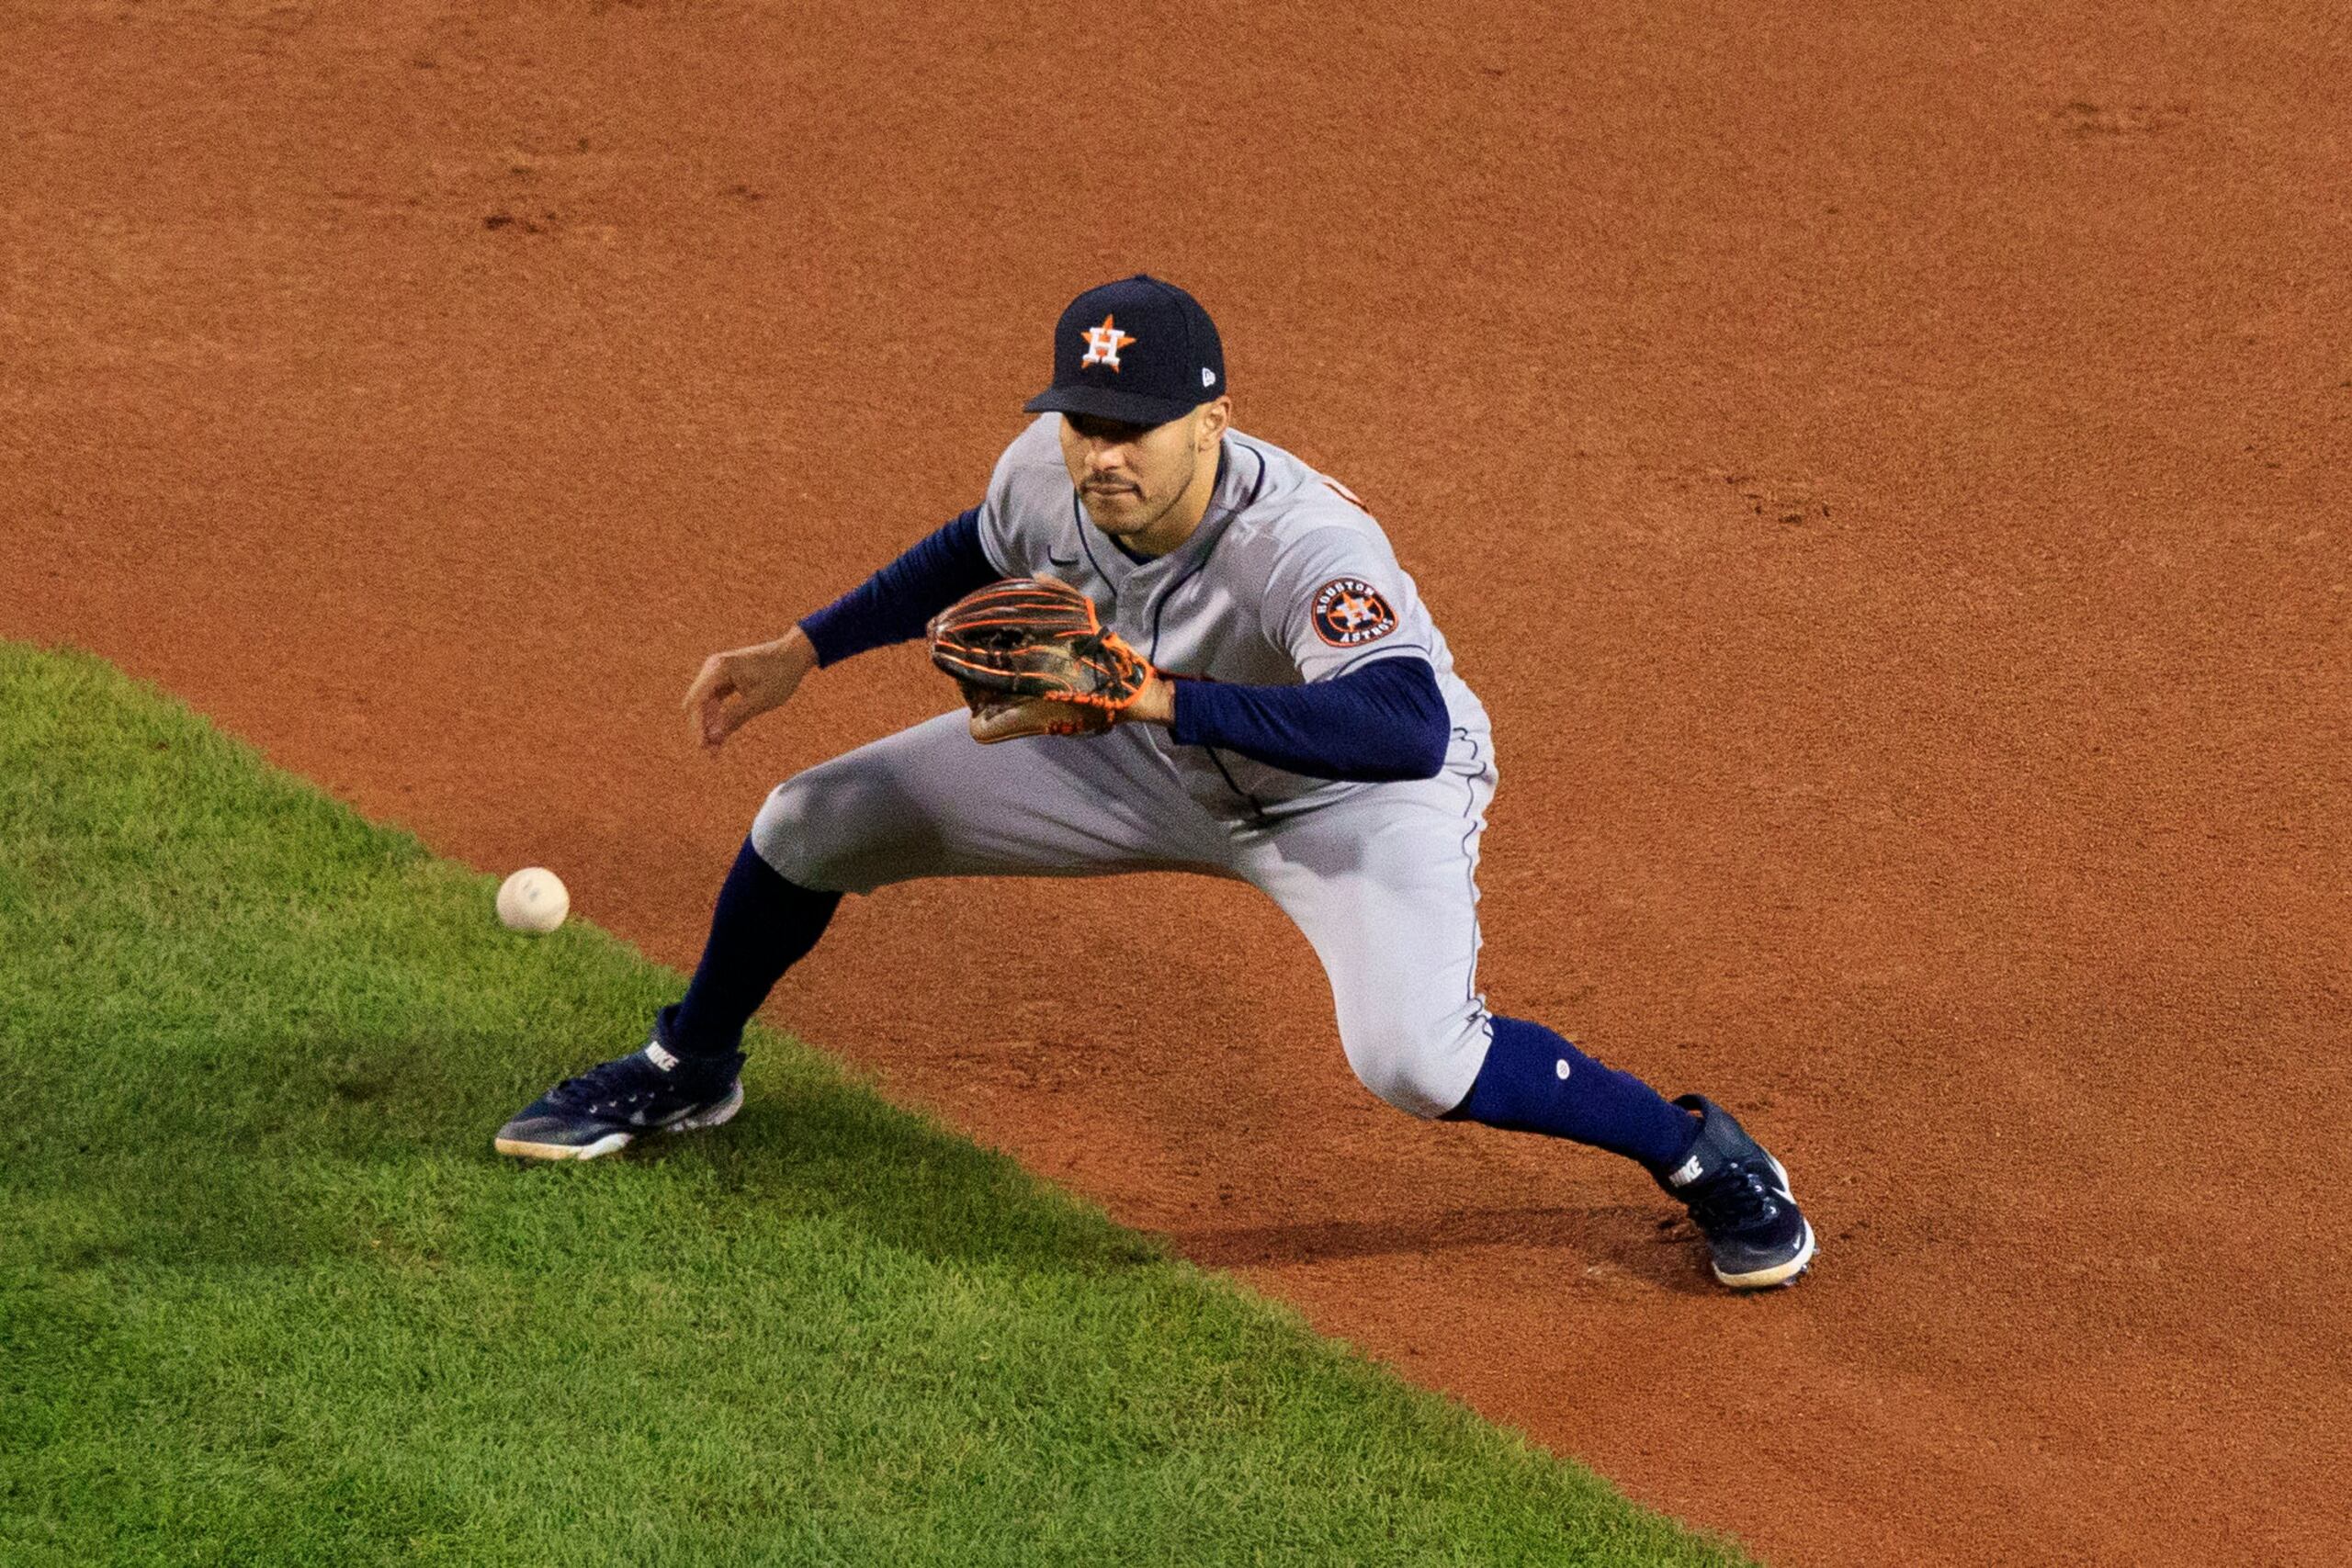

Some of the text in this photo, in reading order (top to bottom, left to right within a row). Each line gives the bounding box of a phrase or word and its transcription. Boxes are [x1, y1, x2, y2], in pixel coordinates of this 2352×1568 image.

[1083, 328, 1125, 366] H
[1317, 581, 1375, 614] HOUSTON
[1340, 618, 1394, 642] ASTROS
[645, 1041, 680, 1072] NIKE
[1668, 1155, 1703, 1188] NIKE
